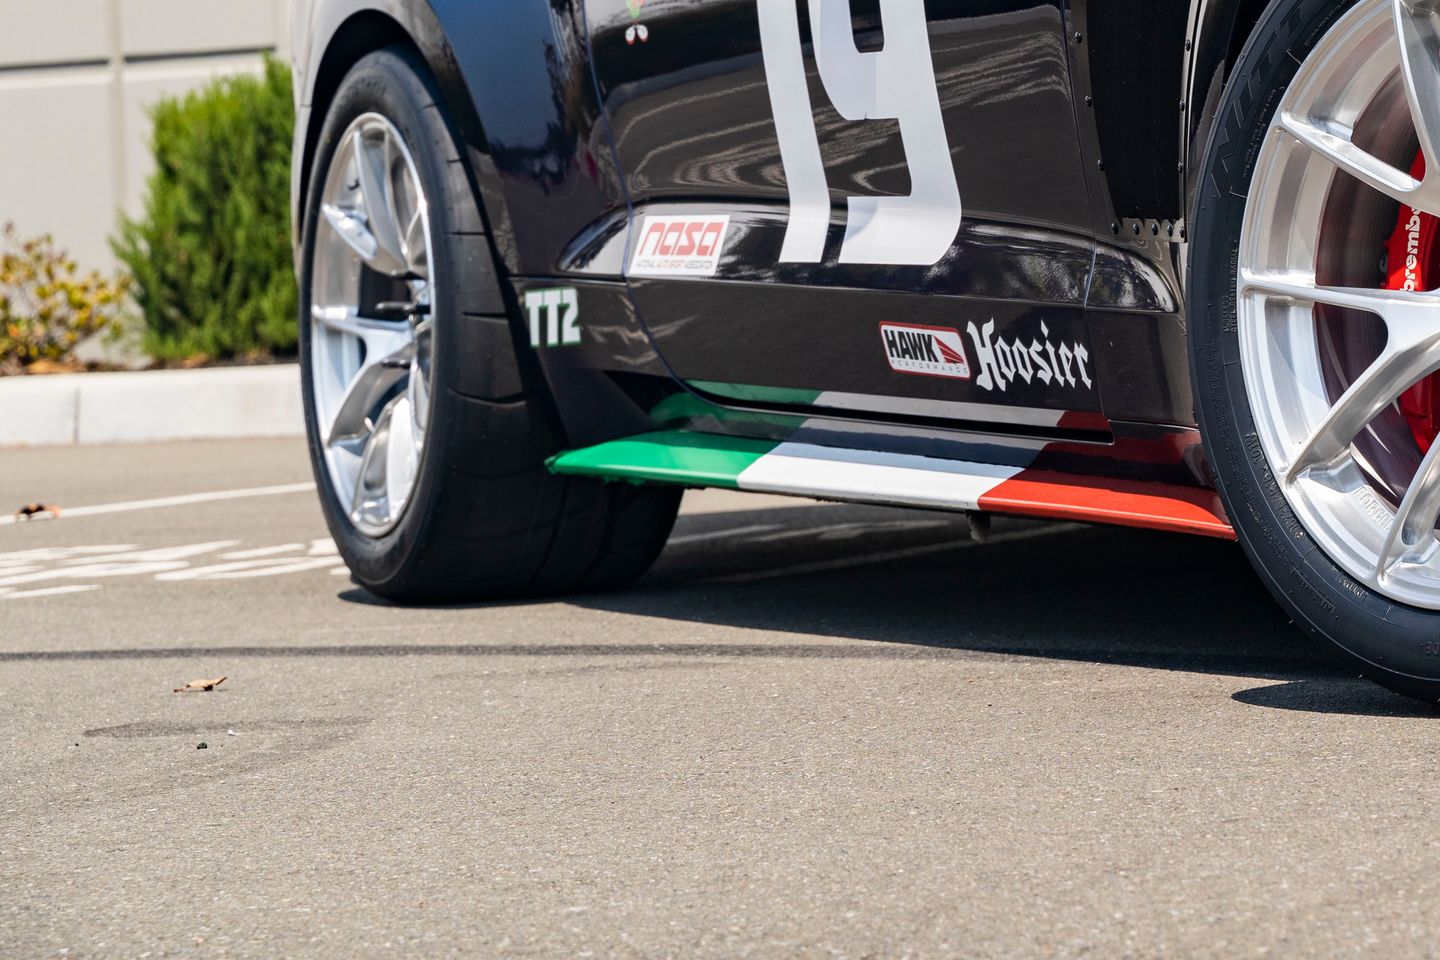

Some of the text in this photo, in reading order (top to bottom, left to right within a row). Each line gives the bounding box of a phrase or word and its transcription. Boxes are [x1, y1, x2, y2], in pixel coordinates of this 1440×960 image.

[524, 286, 582, 348] TT2
[883, 329, 940, 363] HAWK
[966, 314, 1092, 392] Hoosier
